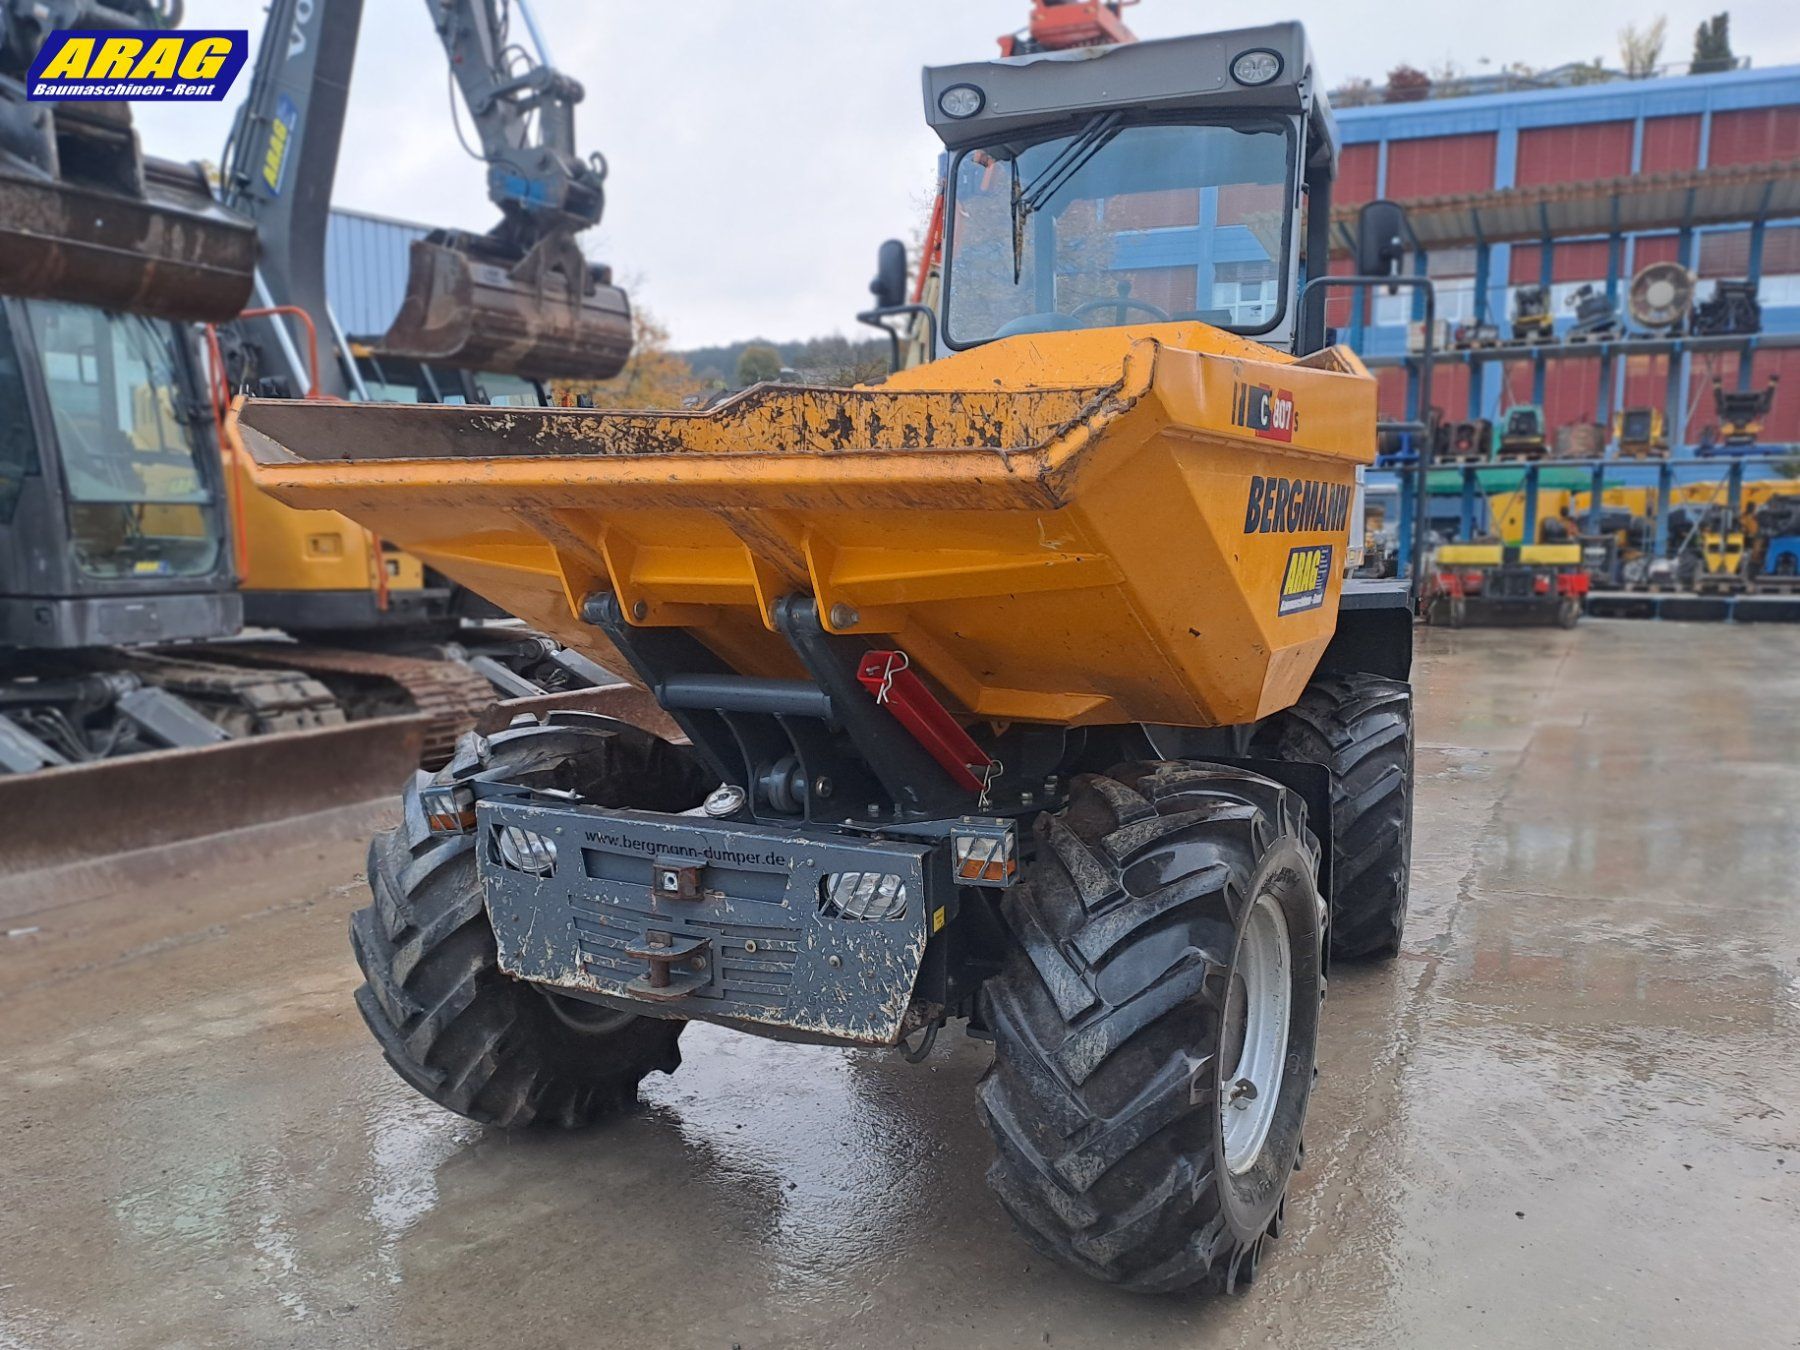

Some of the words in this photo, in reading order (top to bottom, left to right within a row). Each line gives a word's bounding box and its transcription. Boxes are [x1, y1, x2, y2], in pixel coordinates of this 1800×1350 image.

[1272, 398, 1292, 430] 807
[1243, 475, 1351, 534] BERGMANN
[1283, 549, 1320, 595] ARAG
[585, 830, 786, 866] www.bergmann-dumper.de
